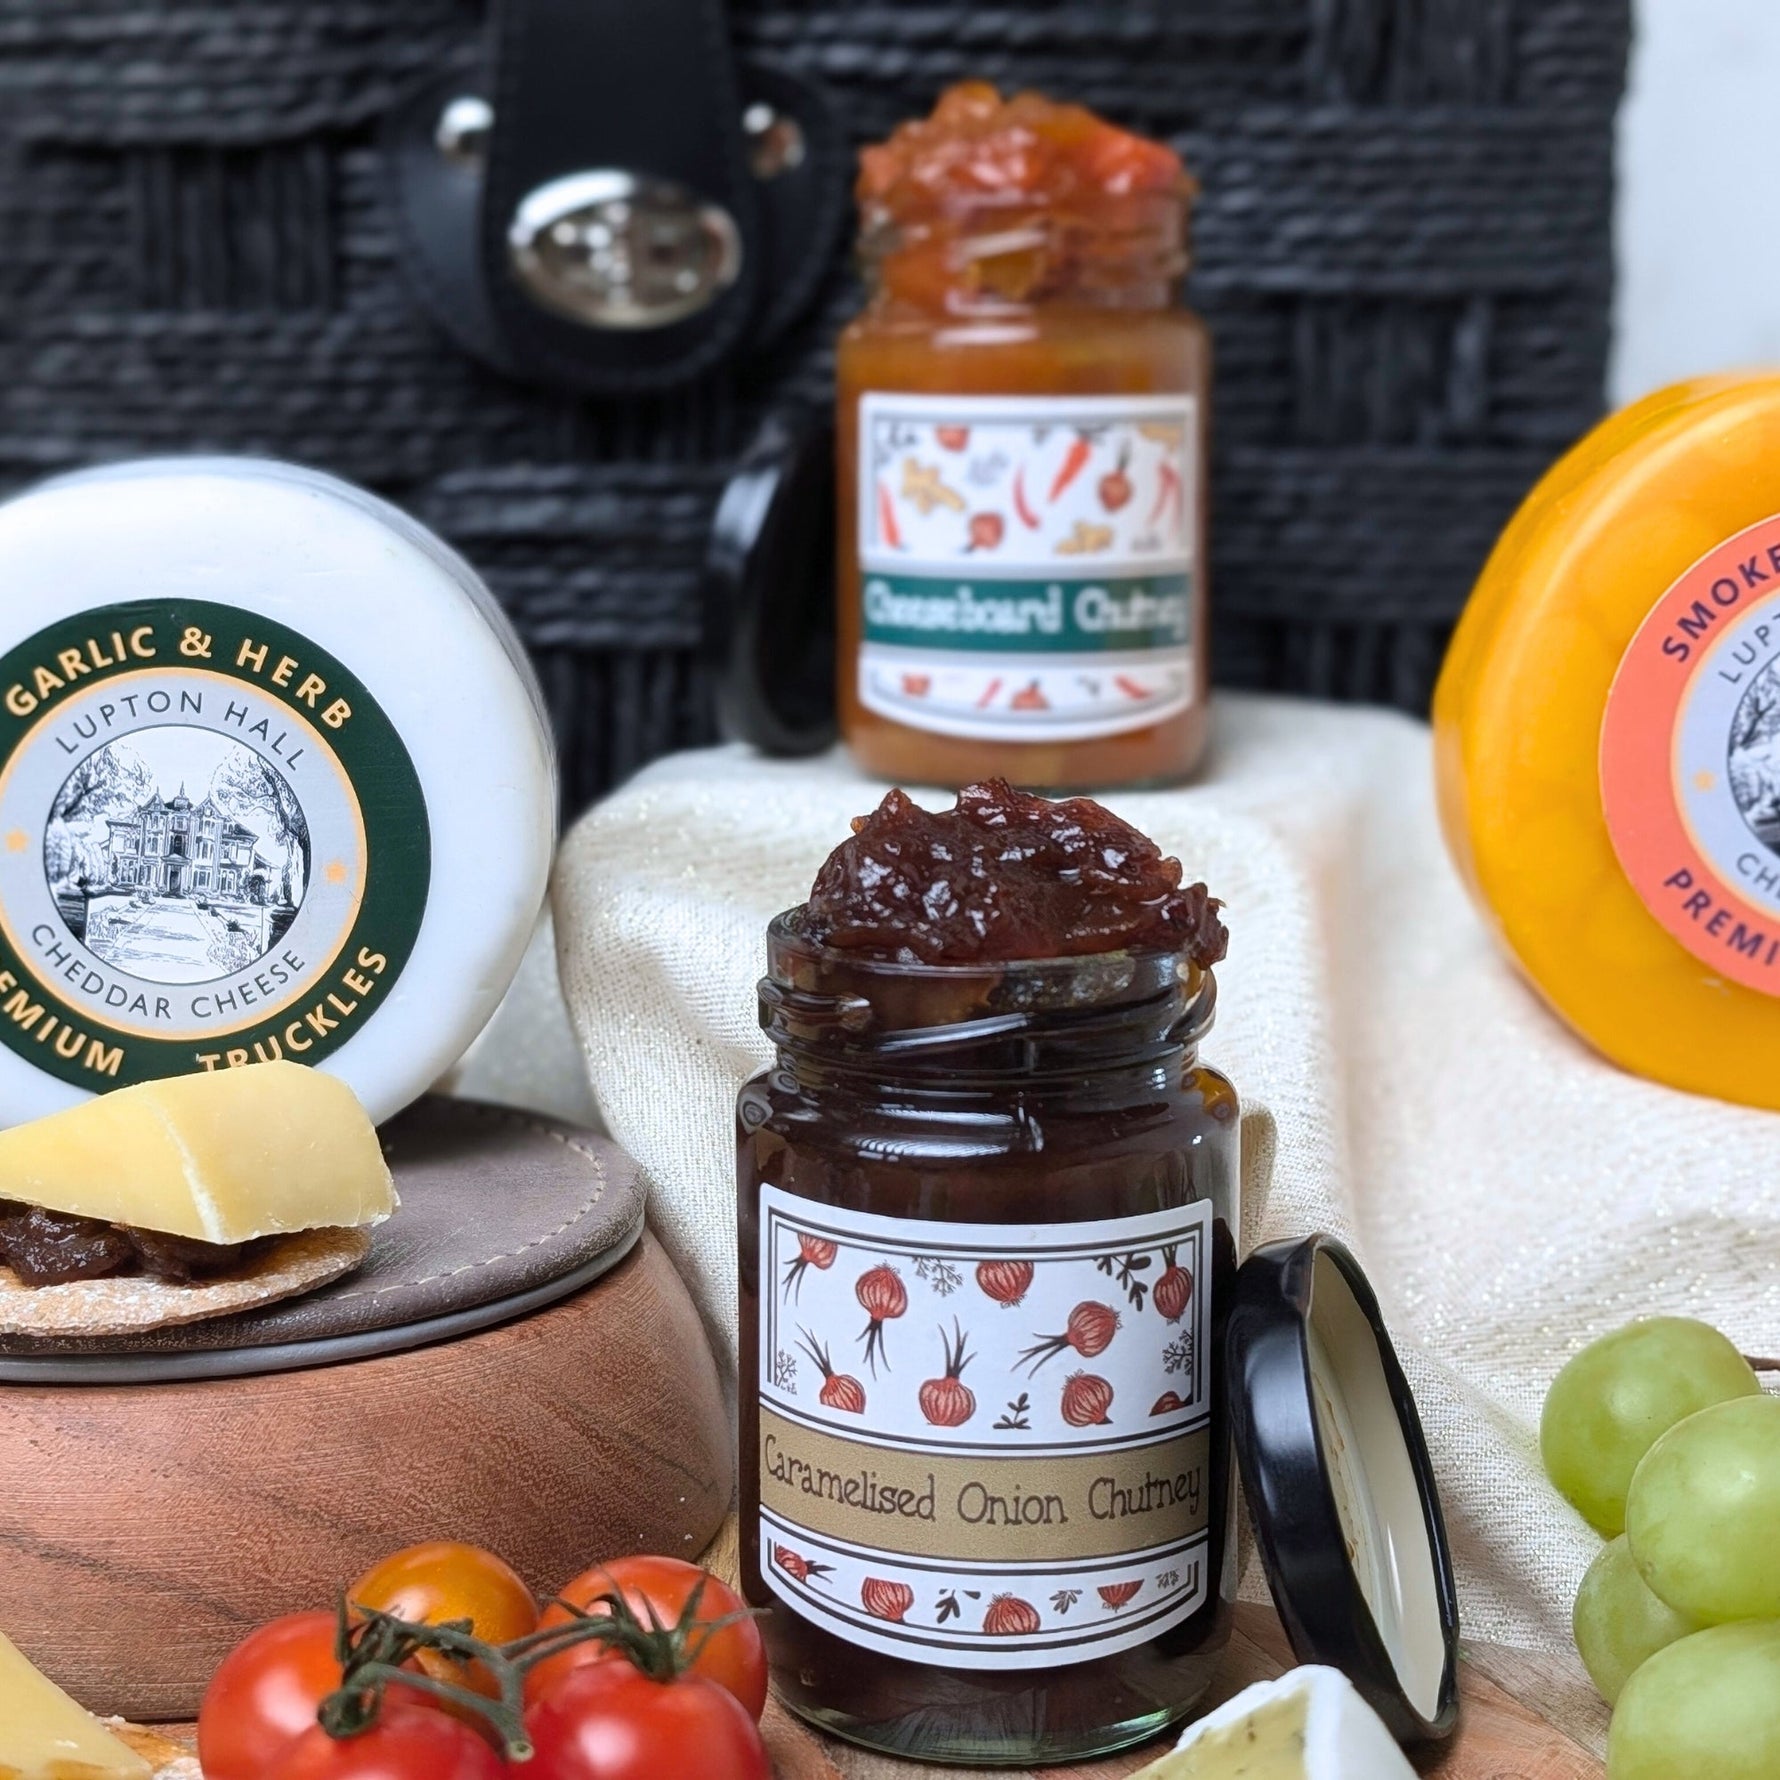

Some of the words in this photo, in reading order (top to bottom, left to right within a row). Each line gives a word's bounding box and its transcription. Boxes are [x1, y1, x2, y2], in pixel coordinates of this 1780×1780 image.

[5, 626, 157, 717] GARLIC
[180, 626, 212, 658] &
[236, 638, 352, 729] HERB
[55, 690, 202, 754] LUPTON
[224, 700, 305, 771] HALL
[1663, 867, 1780, 967] PREMI
[1737, 853, 1780, 899] CH
[32, 924, 172, 1020] CHEDDAR
[191, 950, 305, 1018] CHEESE
[198, 946, 387, 1073] TRUCKLES
[765, 1434, 936, 1522] Caramelised
[957, 1481, 1069, 1525] Onion
[1088, 1467, 1200, 1516] Chutney
